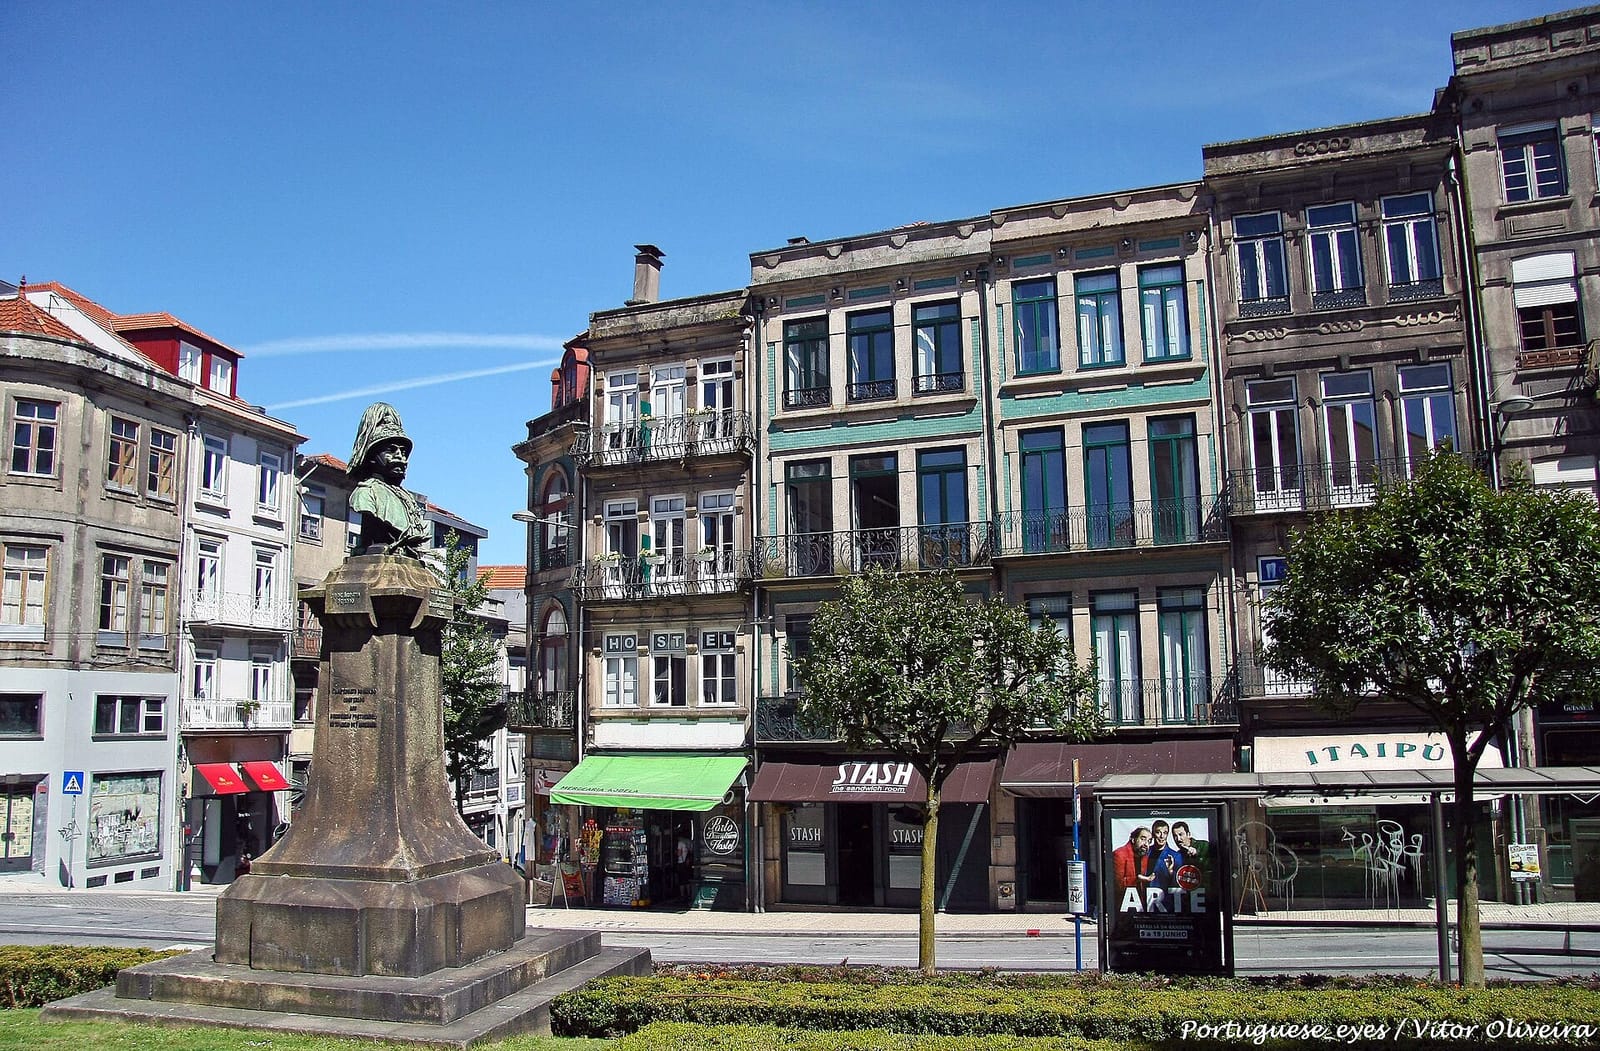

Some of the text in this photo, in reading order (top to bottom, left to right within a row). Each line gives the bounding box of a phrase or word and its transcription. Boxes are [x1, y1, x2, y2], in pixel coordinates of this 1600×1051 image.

[609, 633, 732, 650] HOSTEL
[1305, 742, 1445, 765] ITAIPÚ
[832, 762, 914, 785] STASH
[832, 785, 845, 793] the
[846, 785, 883, 793] sandwich
[708, 817, 733, 832] Porto
[791, 827, 821, 841] STASH
[893, 829, 923, 843] STASH
[1120, 887, 1206, 913] ARTE
